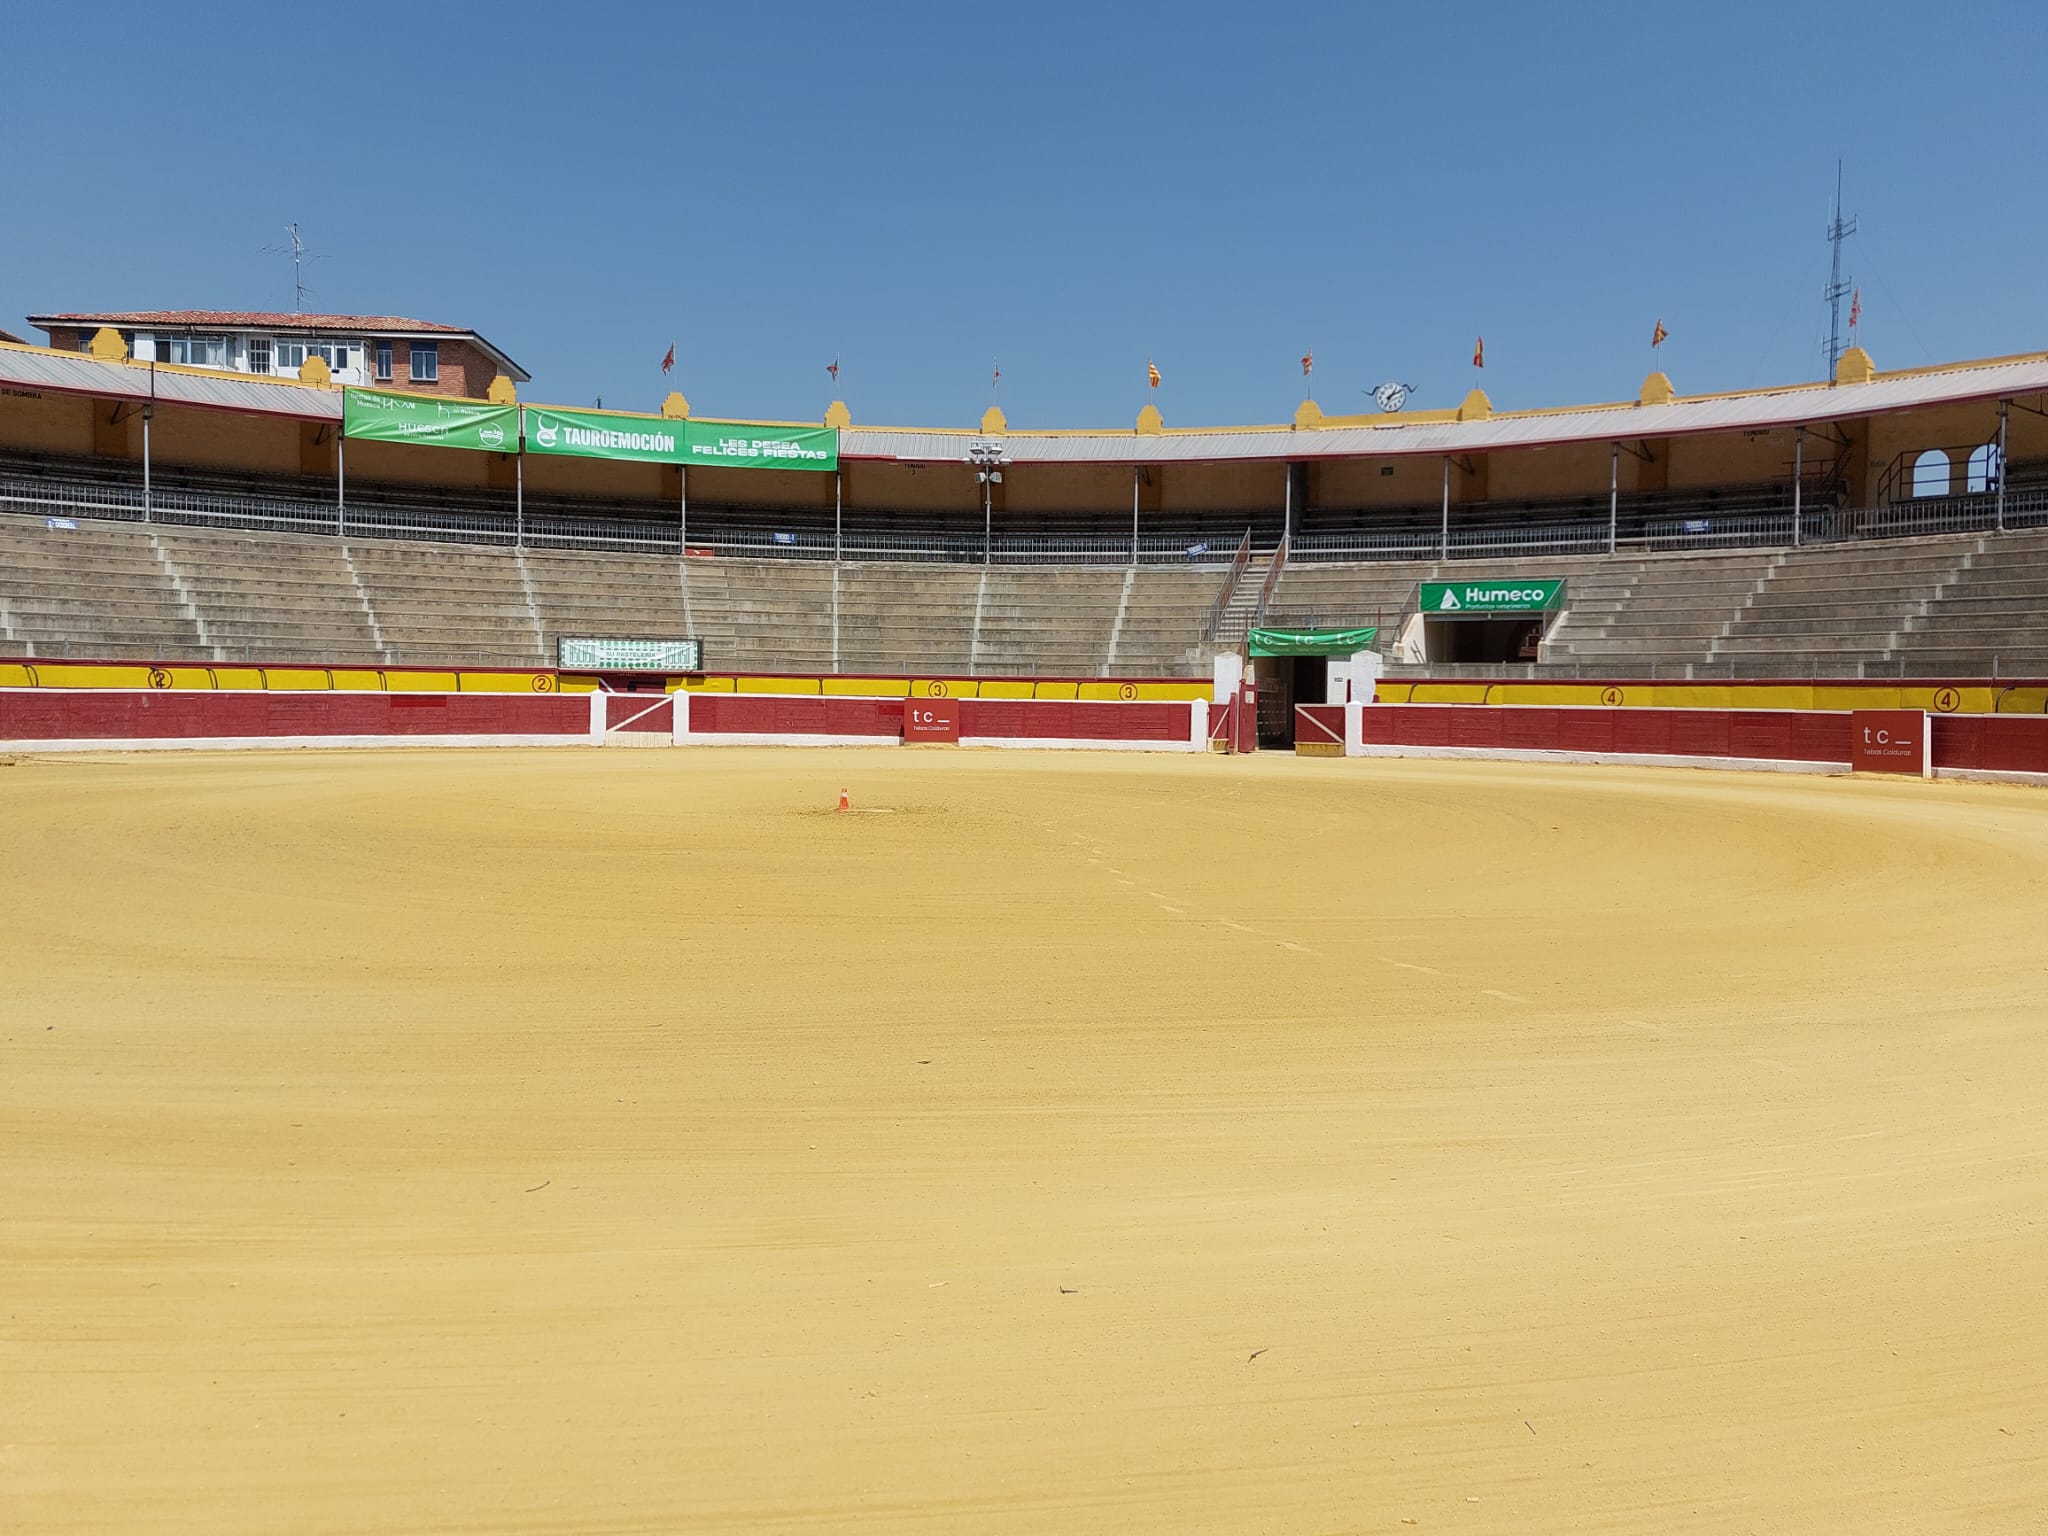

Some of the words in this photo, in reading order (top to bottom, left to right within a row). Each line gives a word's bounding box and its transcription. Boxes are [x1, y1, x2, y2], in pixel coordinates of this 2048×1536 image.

[13, 389, 42, 399] SOMBRA
[563, 427, 675, 452] TAUROEMOCIÓN
[719, 438, 747, 448] LES
[692, 445, 758, 457] FELICES
[763, 448, 827, 460] FIESTAS
[1465, 587, 1545, 602] Humeco
[1863, 748, 1882, 756] Tebas
